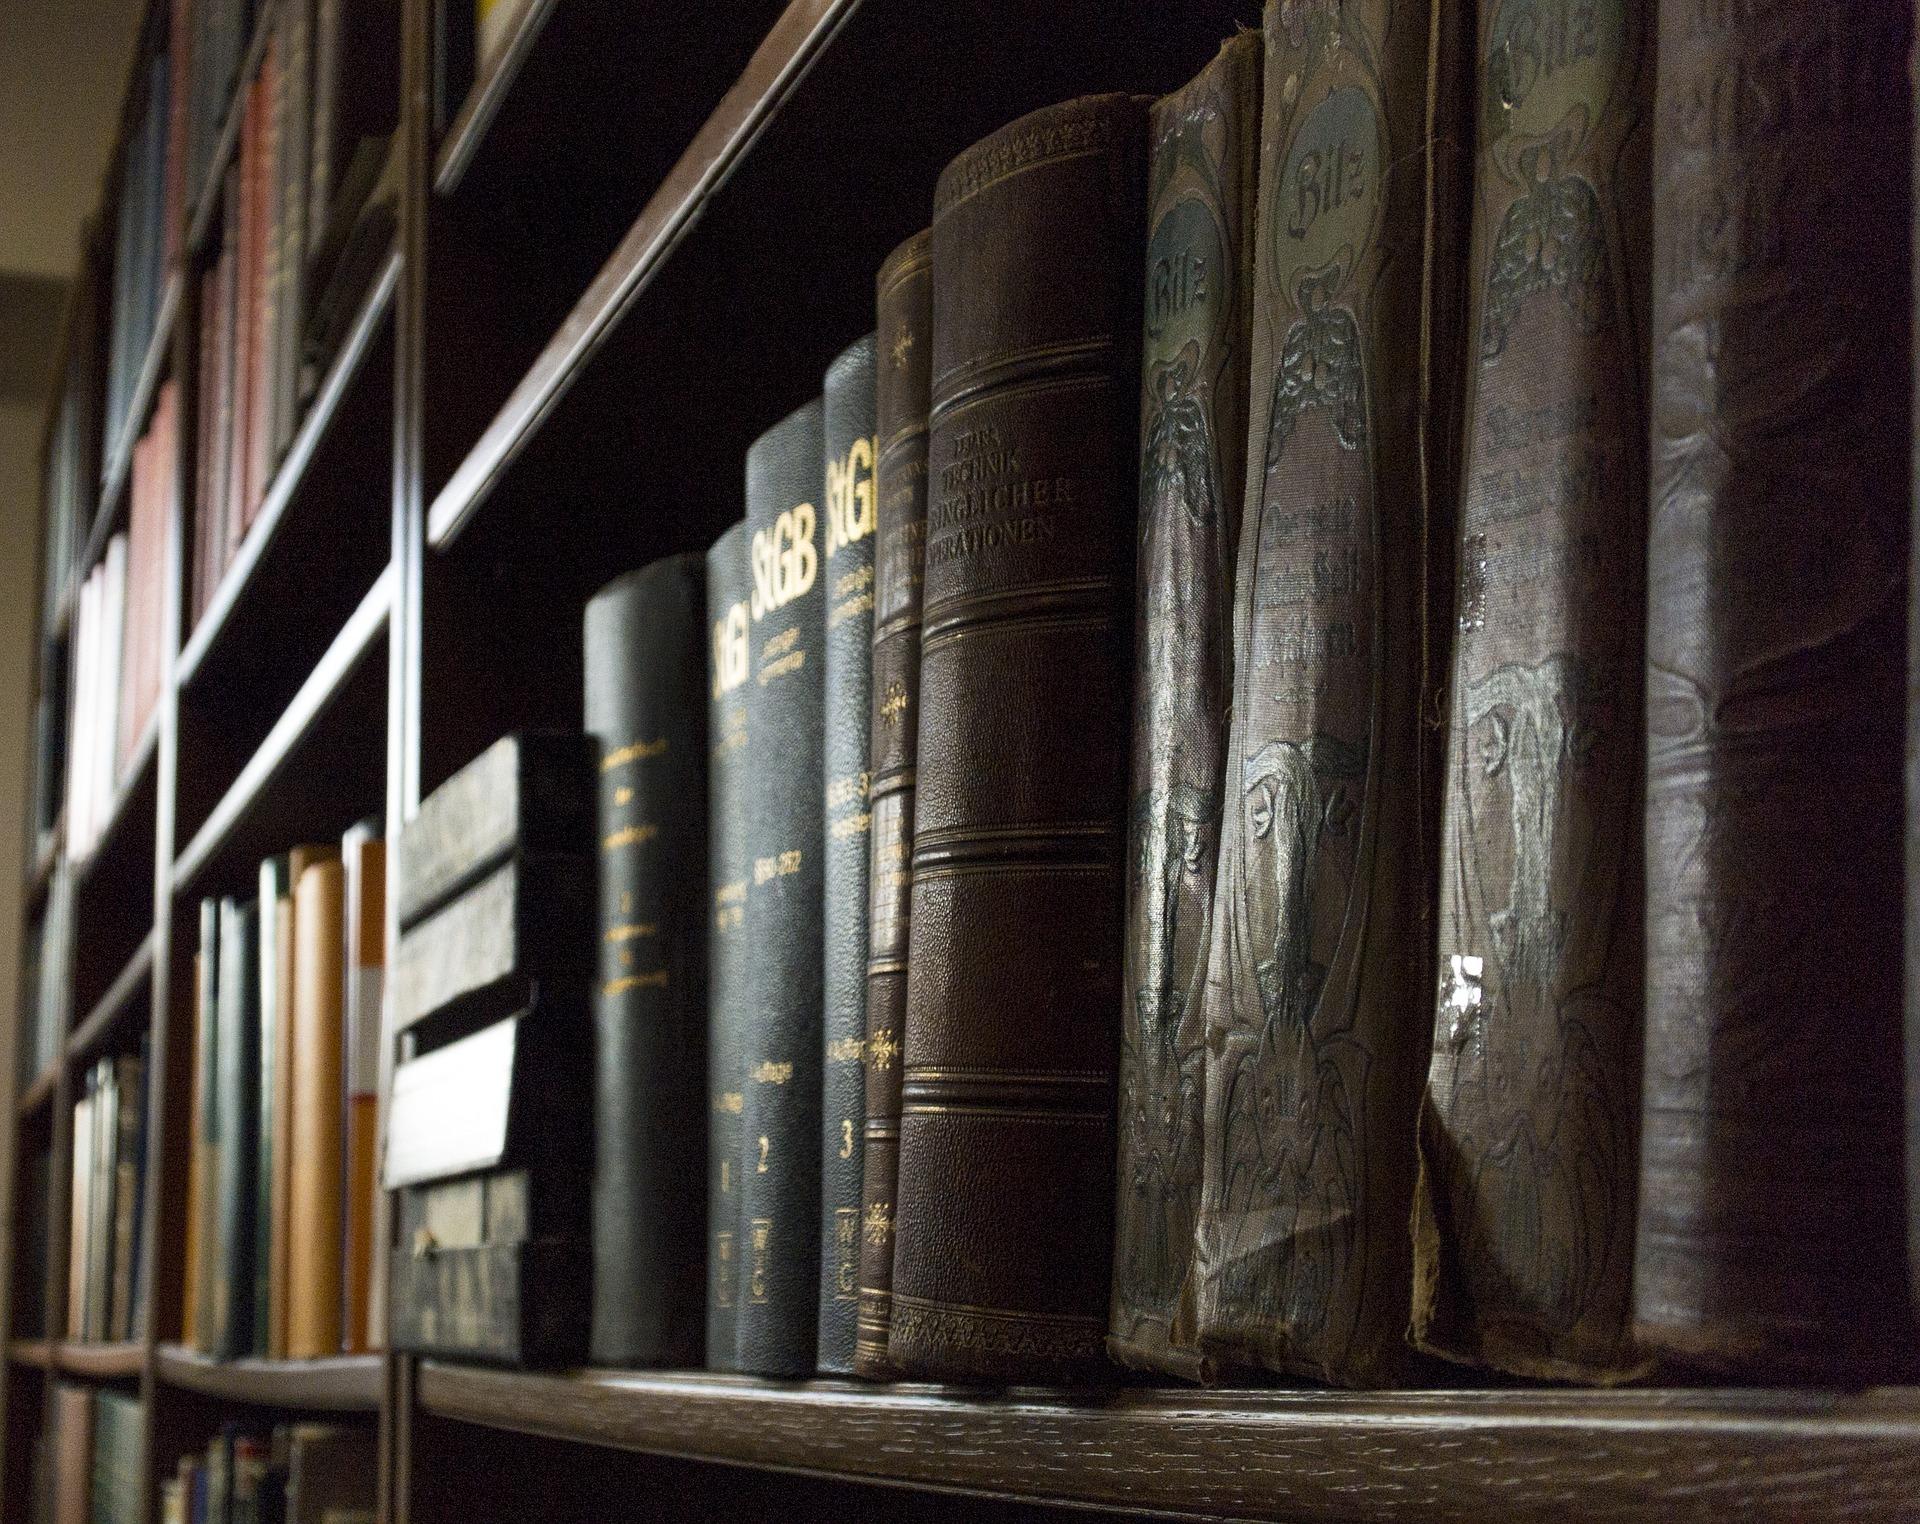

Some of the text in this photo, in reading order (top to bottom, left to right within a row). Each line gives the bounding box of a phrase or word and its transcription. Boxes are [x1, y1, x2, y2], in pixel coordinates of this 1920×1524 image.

[826, 435, 878, 559] StG
[756, 1136, 769, 1174] 2
[839, 1119, 853, 1159] 3
